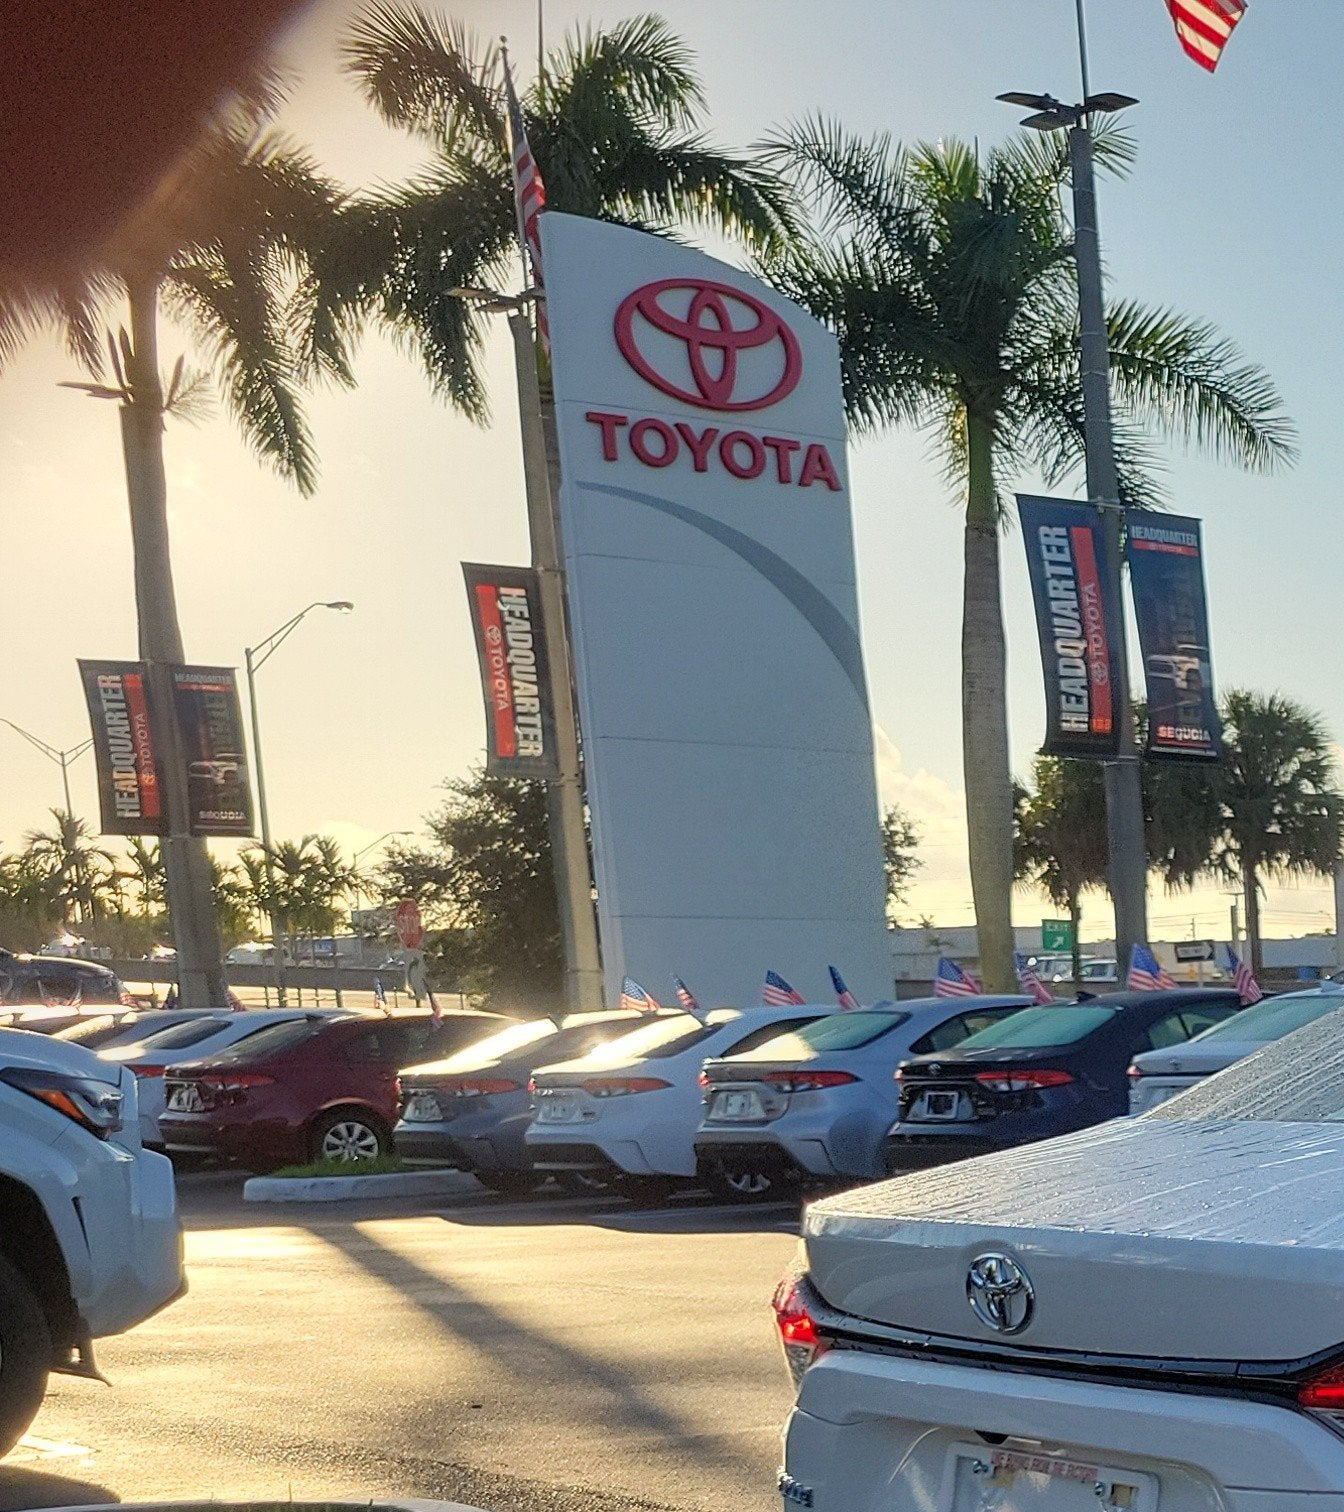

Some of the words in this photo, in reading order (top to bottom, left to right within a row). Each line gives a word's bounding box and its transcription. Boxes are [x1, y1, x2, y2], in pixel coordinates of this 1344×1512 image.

[585, 411, 843, 492] TOYOTA
[1038, 526, 1089, 732] HEADQUARTER
[1080, 582, 1104, 656] TOYOTA
[489, 649, 509, 710] TOYOTA
[498, 586, 543, 757] HEADQUARTER
[98, 675, 141, 818] HEADQUARTER
[135, 713, 153, 774] TOYOTA
[1158, 726, 1211, 741] SEQUOIA
